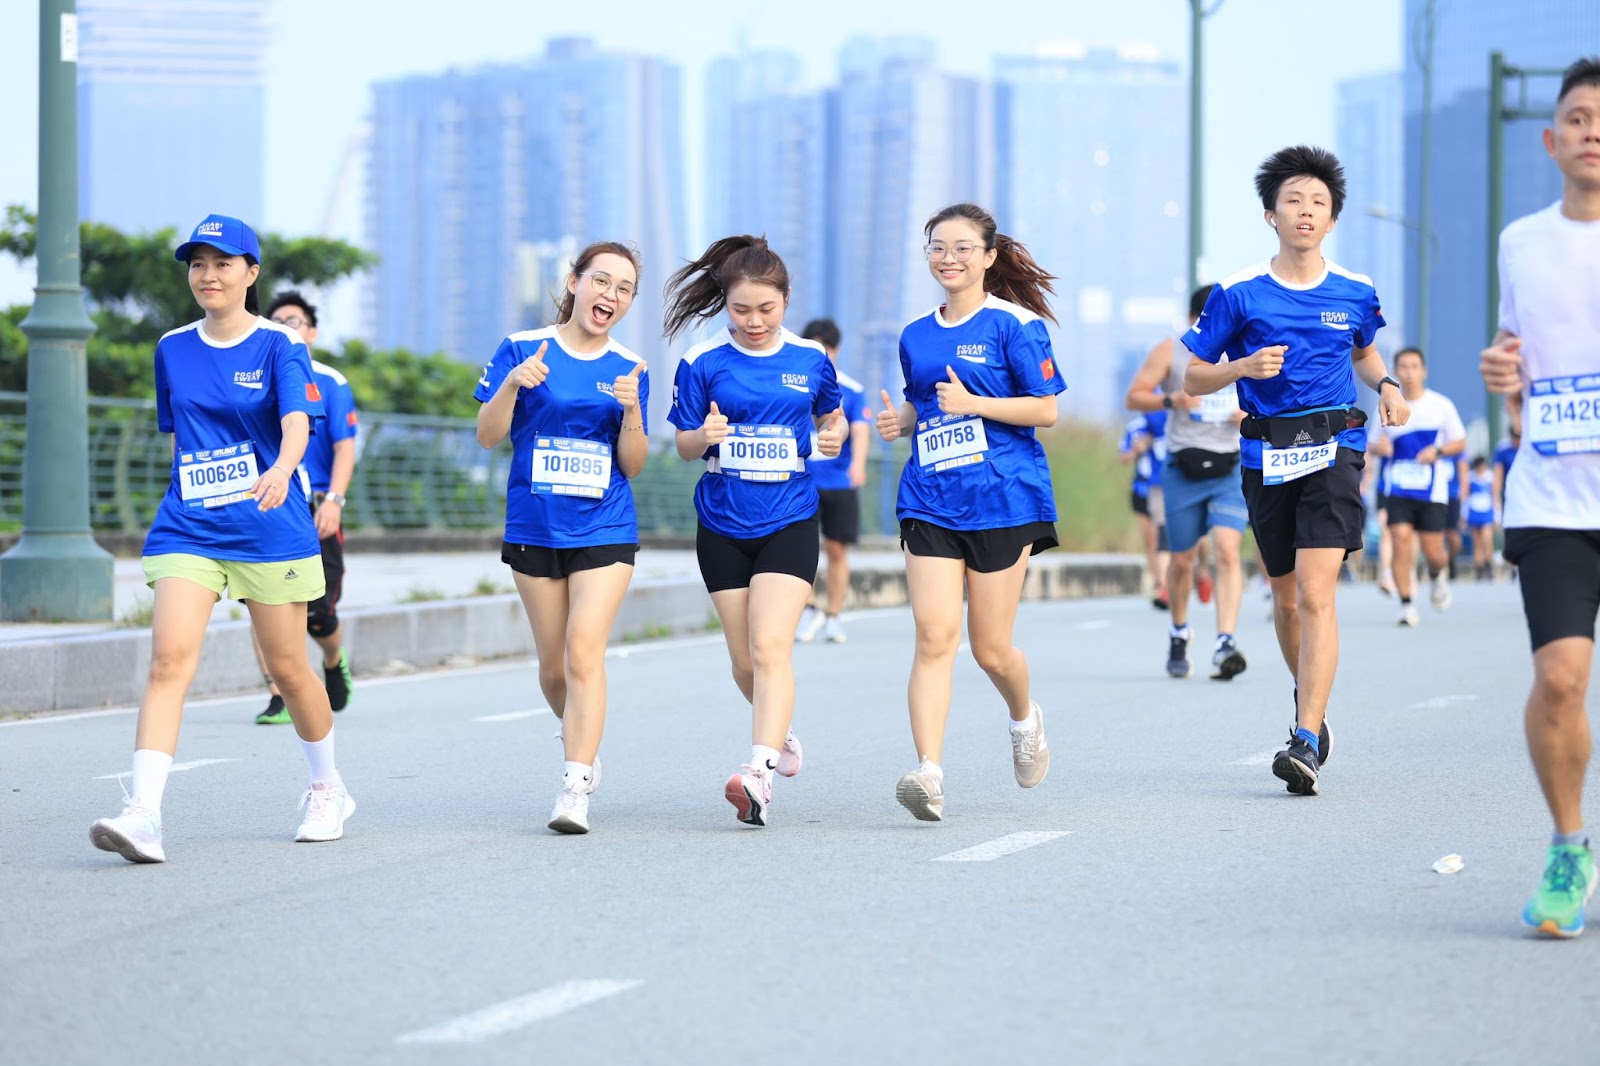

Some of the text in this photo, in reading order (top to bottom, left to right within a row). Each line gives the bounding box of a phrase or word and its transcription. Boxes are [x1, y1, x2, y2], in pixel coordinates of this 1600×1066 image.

[234, 369, 263, 377] POCARI
[924, 425, 975, 452] 101758
[728, 441, 789, 459] 101686
[1271, 447, 1329, 467] 213425
[187, 461, 249, 487] 100629
[542, 454, 603, 476] 101895
